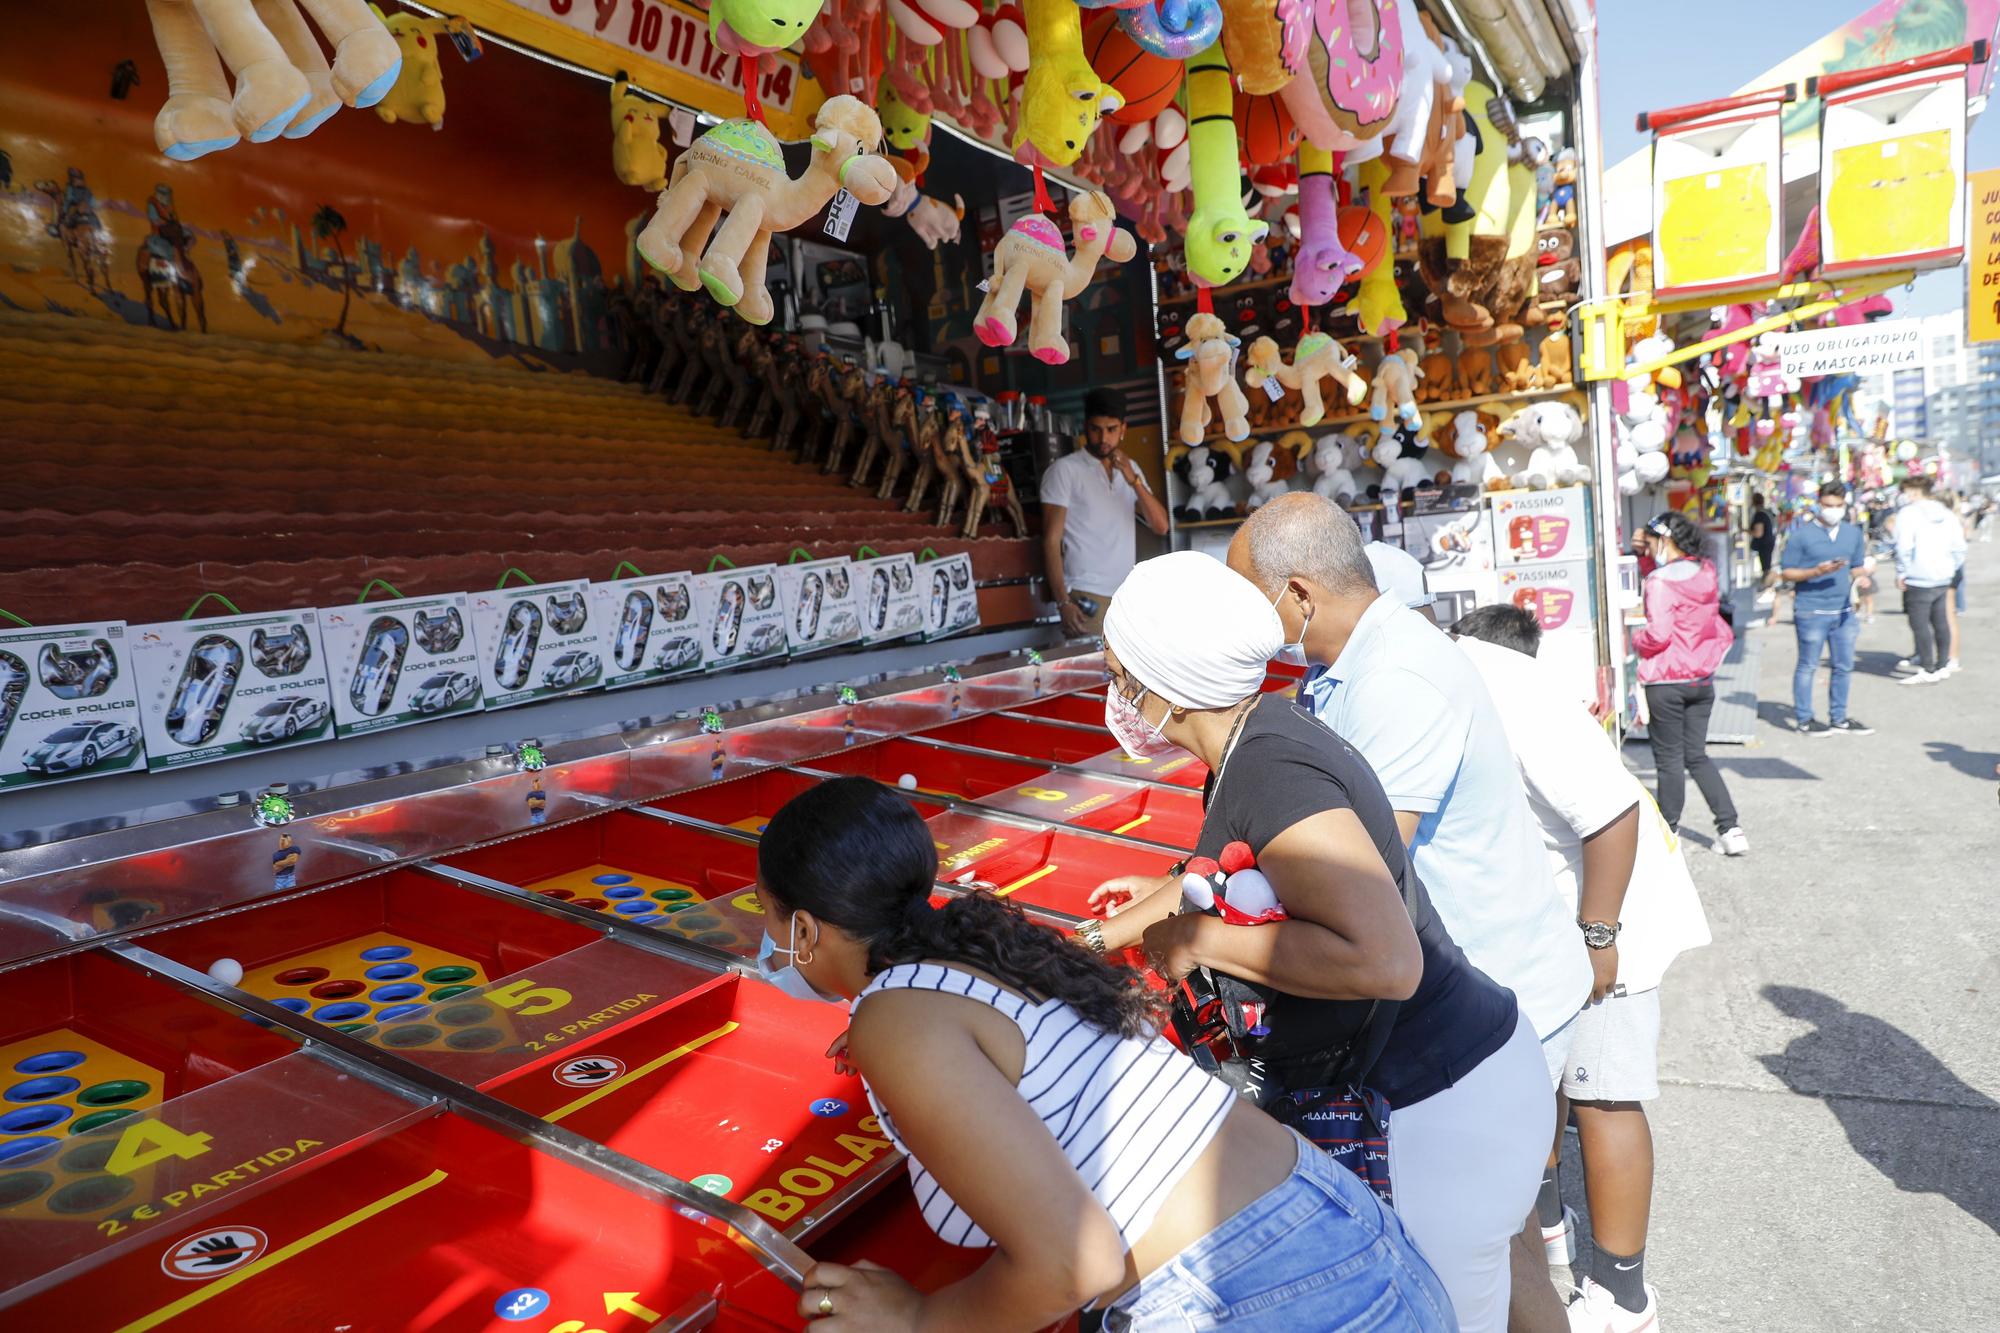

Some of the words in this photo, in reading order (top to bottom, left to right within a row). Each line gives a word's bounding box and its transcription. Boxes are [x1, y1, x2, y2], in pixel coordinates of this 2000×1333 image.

[628, 0, 662, 52] 10
[667, 14, 695, 66] 11
[691, 150, 728, 169] RACING
[734, 166, 771, 191] CAMEL
[1982, 190, 2000, 205] JU
[1783, 343, 1810, 356] USO
[1816, 331, 1918, 352] OBLIGATORIO
[1786, 361, 1807, 374] DE
[1813, 350, 1916, 371] MASCARILLA
[1514, 496, 1564, 510] TASSIMO
[1517, 569, 1568, 582] TASSIMO
[651, 626, 672, 637] COCHE
[539, 641, 566, 651] COCHE
[404, 661, 437, 672] COCHE
[236, 684, 277, 697] COCHE
[19, 708, 73, 721] COCHE
[76, 699, 137, 714] POLICIA
[1017, 786, 1068, 801] 8
[483, 978, 573, 1016] 5
[524, 1041, 547, 1052] 2
[545, 1032, 565, 1043] €
[560, 992, 659, 1035] PARTIDA
[819, 1101, 841, 1115] x2
[104, 1118, 214, 1177] 4
[97, 1219, 128, 1237] 2
[131, 1204, 161, 1220] €
[162, 1138, 324, 1207] PARTIDA
[506, 1293, 540, 1316] x2
